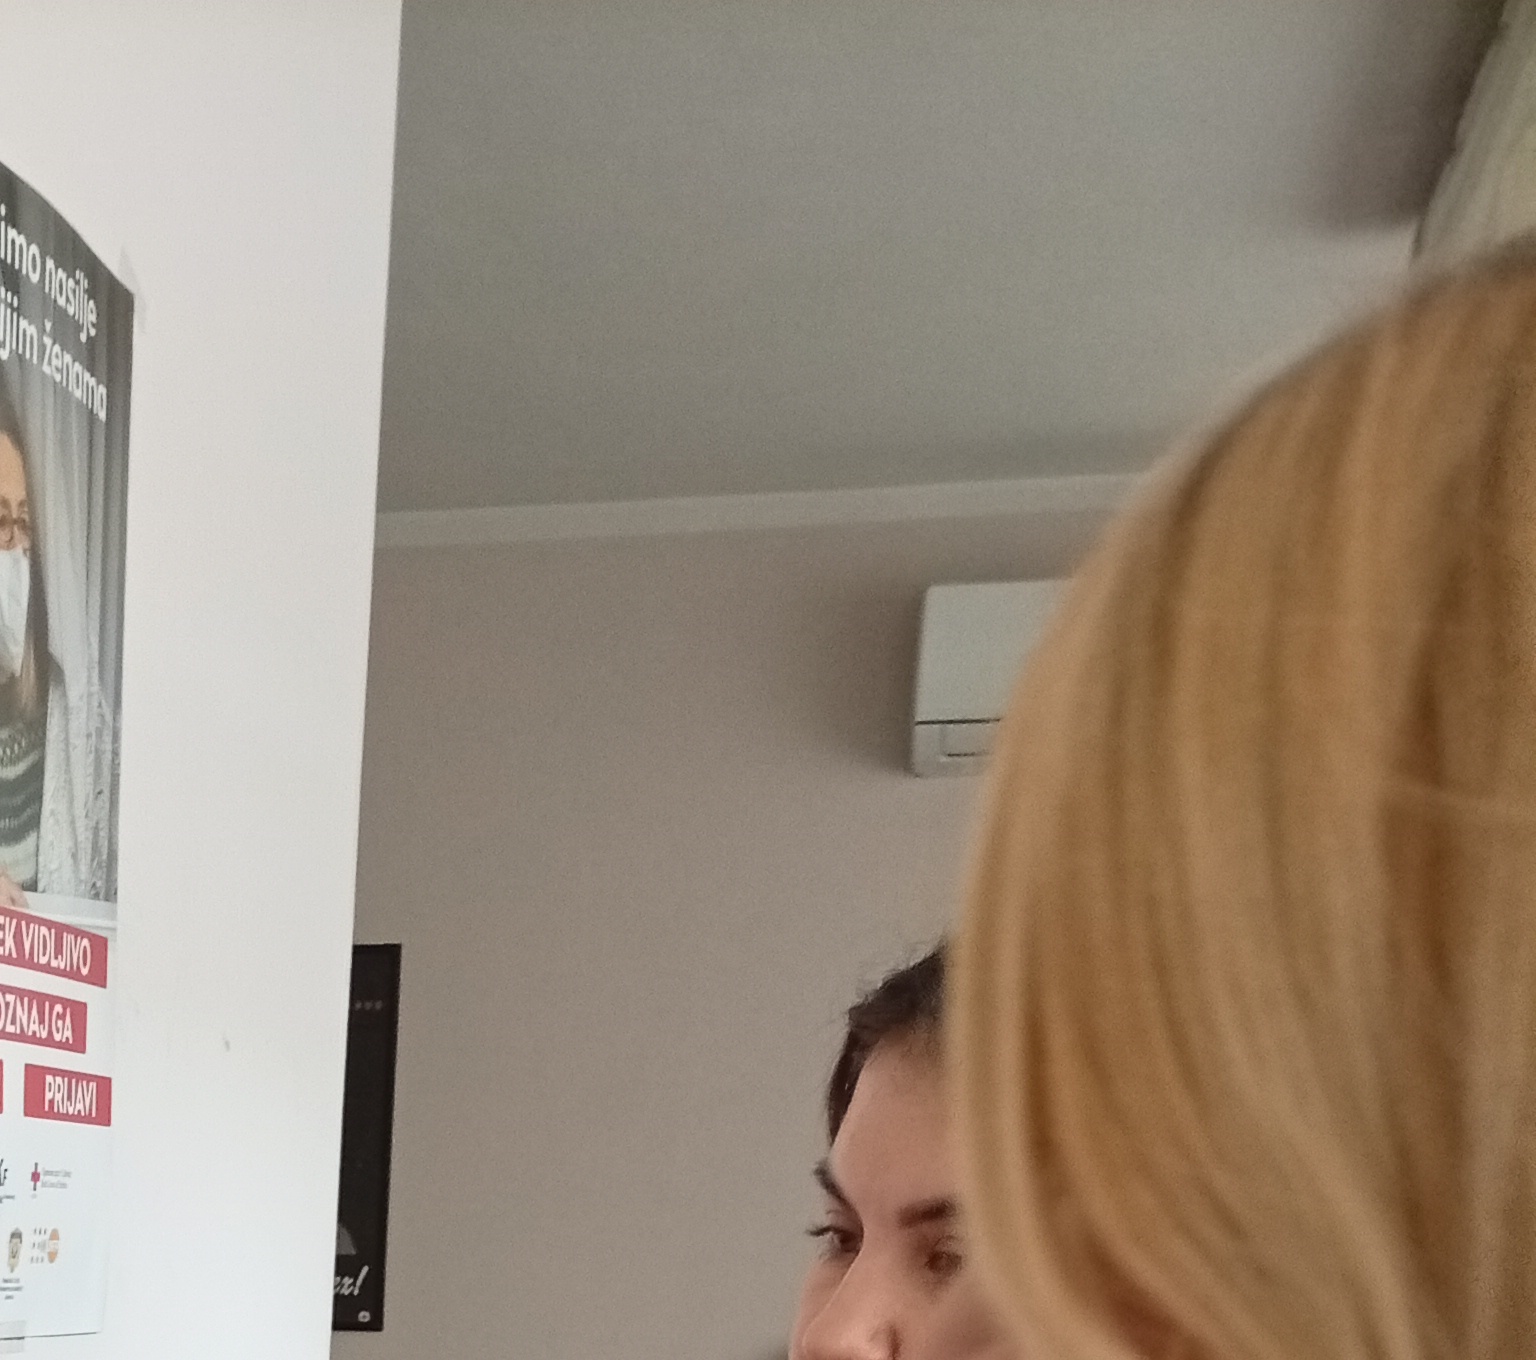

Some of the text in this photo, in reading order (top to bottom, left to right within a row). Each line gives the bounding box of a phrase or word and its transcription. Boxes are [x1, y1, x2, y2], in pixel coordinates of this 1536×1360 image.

[45, 254, 97, 343] nasilje
[42, 319, 107, 423] ženama
[21, 920, 91, 977] VIDLJIVO
[52, 1003, 73, 1044] GA
[44, 1075, 97, 1118] PRIJAVI
